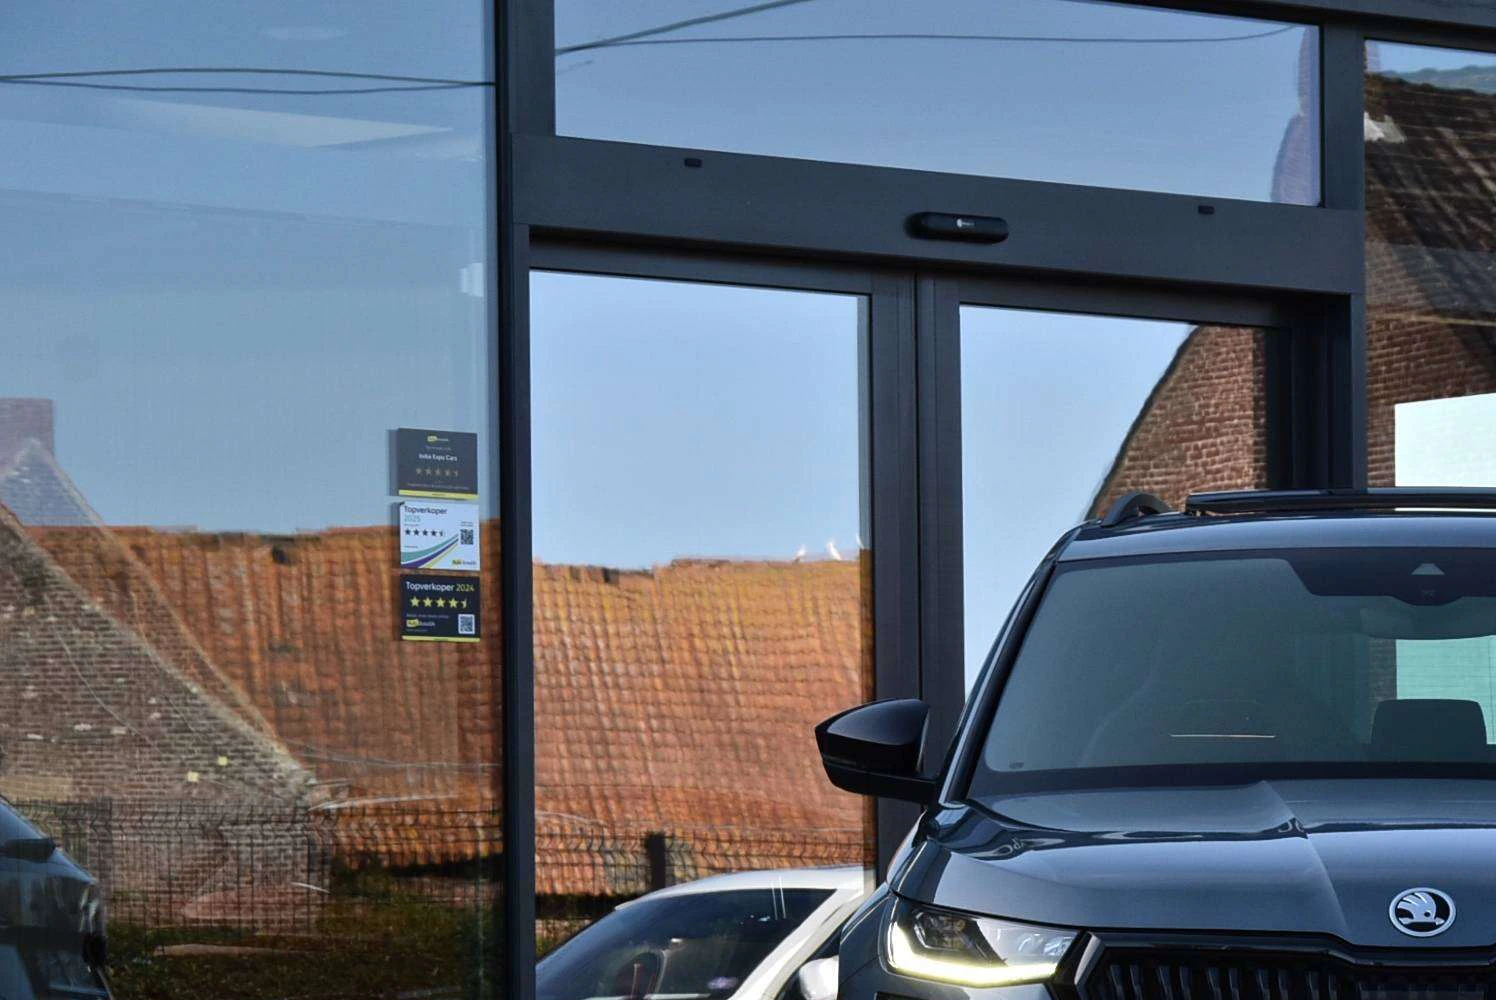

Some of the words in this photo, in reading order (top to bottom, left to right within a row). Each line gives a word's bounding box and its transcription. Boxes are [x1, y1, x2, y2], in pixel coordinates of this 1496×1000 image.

[404, 505, 447, 515] Topverkoper
[406, 581, 455, 592] Topverkoper
[456, 583, 474, 592] 2024
